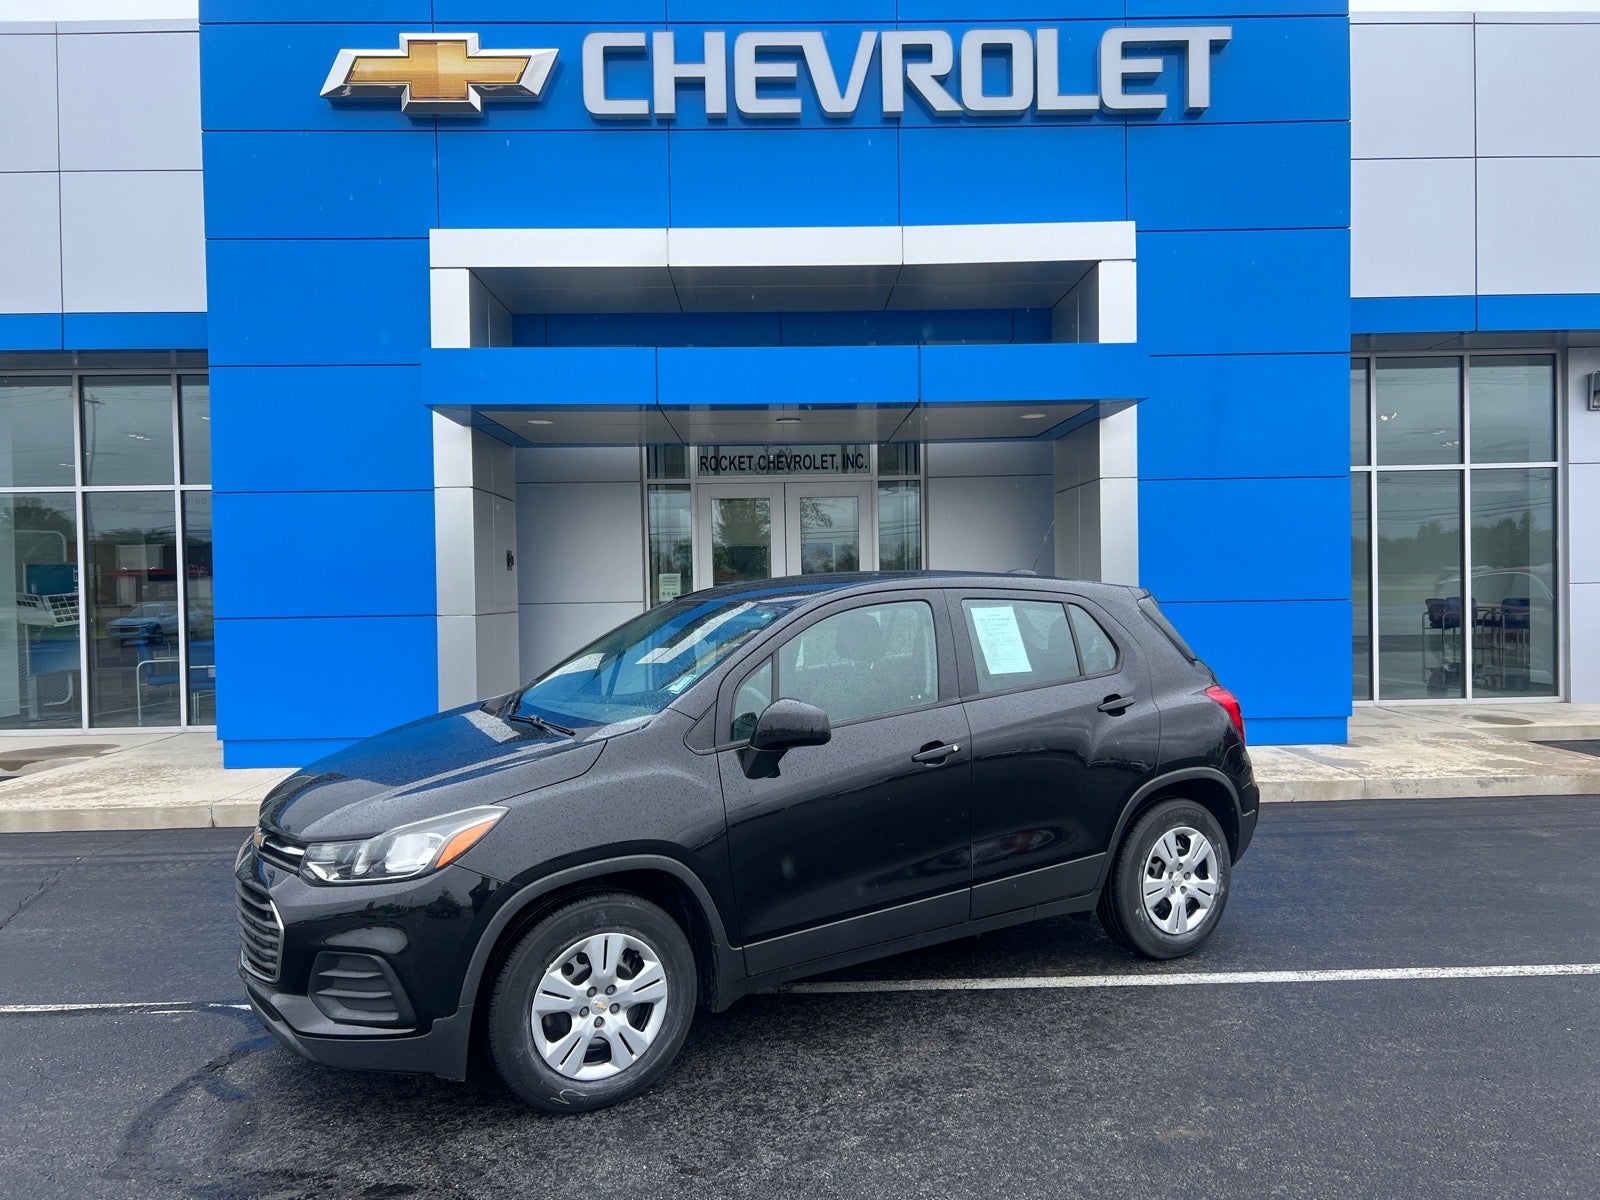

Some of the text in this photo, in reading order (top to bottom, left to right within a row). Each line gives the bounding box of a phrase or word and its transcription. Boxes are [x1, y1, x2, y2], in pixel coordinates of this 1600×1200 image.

[582, 25, 1232, 117] CHEVROLET
[700, 452, 868, 472] ROCKET CHEVROLET, INC.
